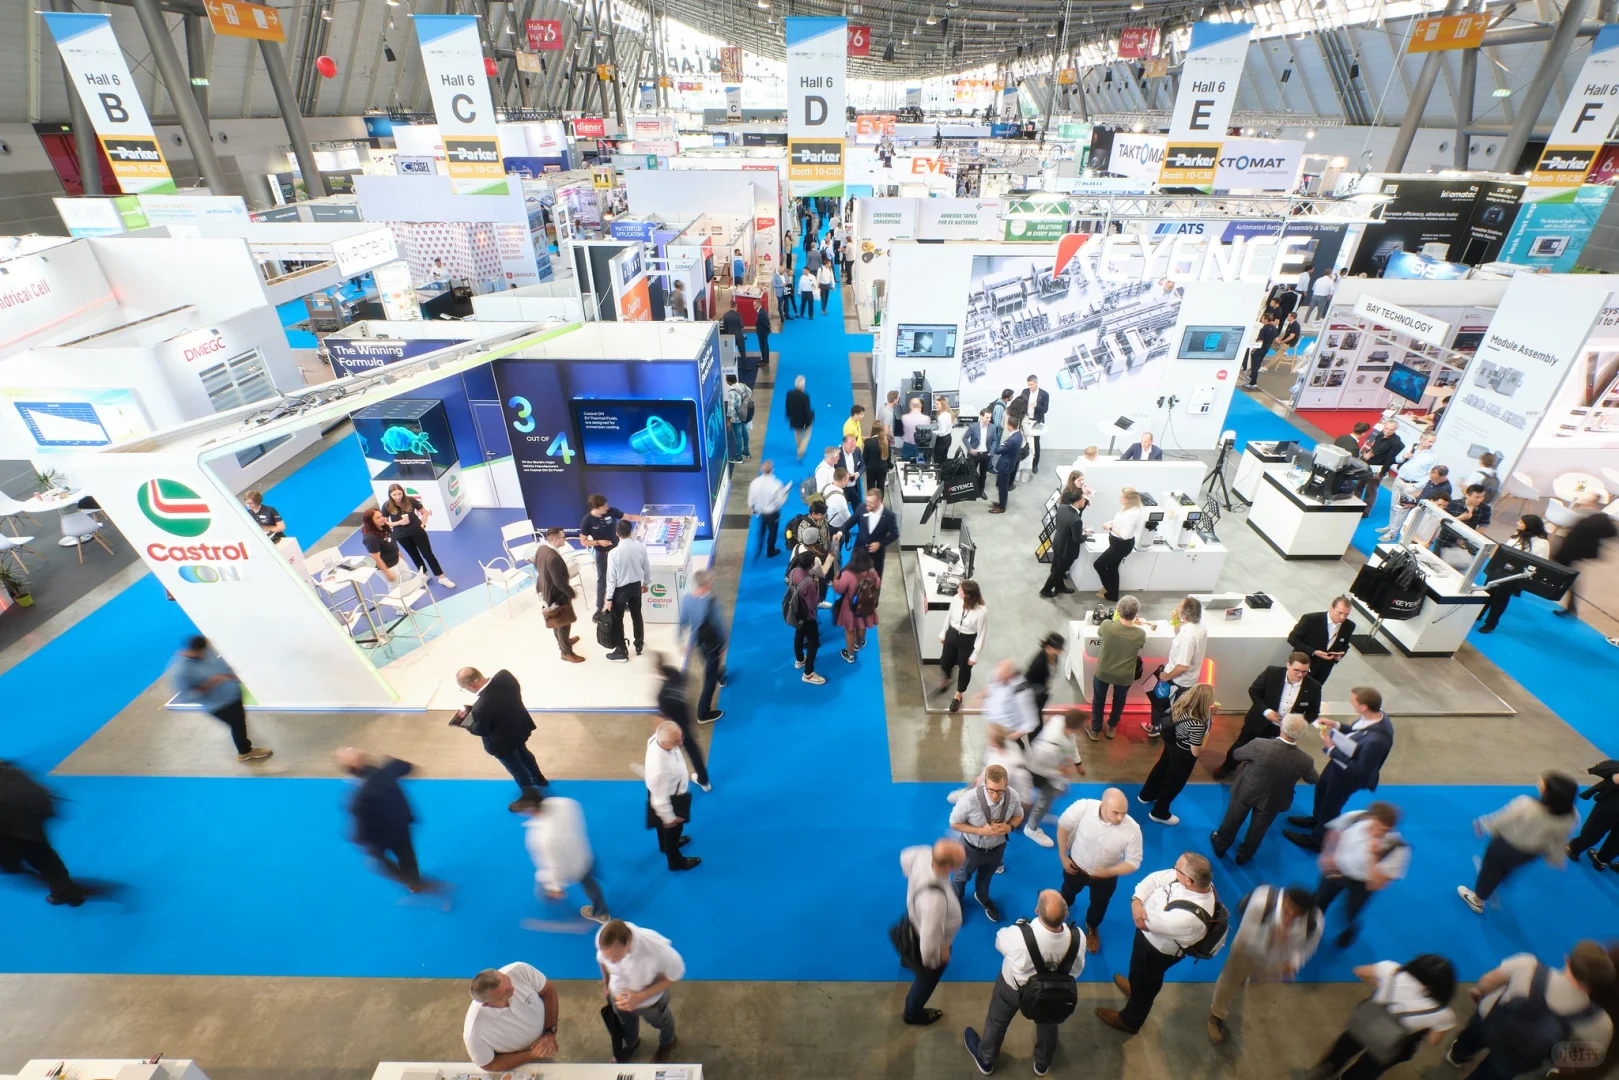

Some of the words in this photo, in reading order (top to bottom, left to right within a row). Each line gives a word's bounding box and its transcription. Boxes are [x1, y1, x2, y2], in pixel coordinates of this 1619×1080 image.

[544, 23, 556, 41] 6
[853, 30, 864, 47] 6
[84, 73, 111, 86] Hall
[112, 74, 121, 86] 6
[440, 74, 465, 86] Hall
[467, 75, 475, 86] 6
[800, 76, 823, 88] Hall
[826, 76, 833, 88] 6
[1192, 81, 1216, 93] Hall
[1217, 82, 1226, 93] 6
[1583, 84, 1610, 96] Hall
[1610, 84, 1619, 96] 6
[98, 92, 129, 122] B
[452, 93, 476, 124] C
[805, 95, 828, 126] D
[1189, 100, 1215, 131] E
[1571, 103, 1604, 133] F
[856, 114, 897, 134] EVE
[115, 146, 159, 160] Parker
[457, 147, 499, 161] Parker
[801, 149, 841, 163] Parker
[1119, 143, 1165, 165] TAKTOMA
[1174, 154, 1216, 167] Parker
[451, 165, 473, 173] Booth
[911, 156, 952, 174] EVE
[1218, 155, 1285, 171] KTOMAT
[1548, 156, 1590, 170] Parker
[791, 167, 813, 176] Booth
[815, 168, 842, 176] 10-C30
[1161, 171, 1184, 180] Booth
[1186, 171, 1213, 180] 10-C30
[1531, 174, 1554, 183] Booth
[1555, 174, 1584, 183] 10-C30
[1177, 223, 1204, 235] ATS
[1286, 224, 1313, 232] Assembly
[1319, 225, 1340, 233] Testing
[1051, 234, 1311, 284] KEYENCE
[1410, 261, 1439, 280] GVS
[33, 278, 51, 299] Cell
[1366, 302, 1381, 314] BAY
[1382, 308, 1434, 334] TECHNOLOGY
[1603, 317, 1614, 326] to
[183, 336, 227, 363] DMEGC
[333, 345, 356, 356] The
[357, 345, 404, 358] Winning
[1490, 334, 1518, 353] Module
[1517, 344, 1559, 368] Assembly
[338, 357, 385, 367] Formula
[508, 395, 536, 433] 3
[546, 431, 576, 465] 4
[948, 482, 974, 492] KEYENCE
[146, 541, 249, 563] Castrol
